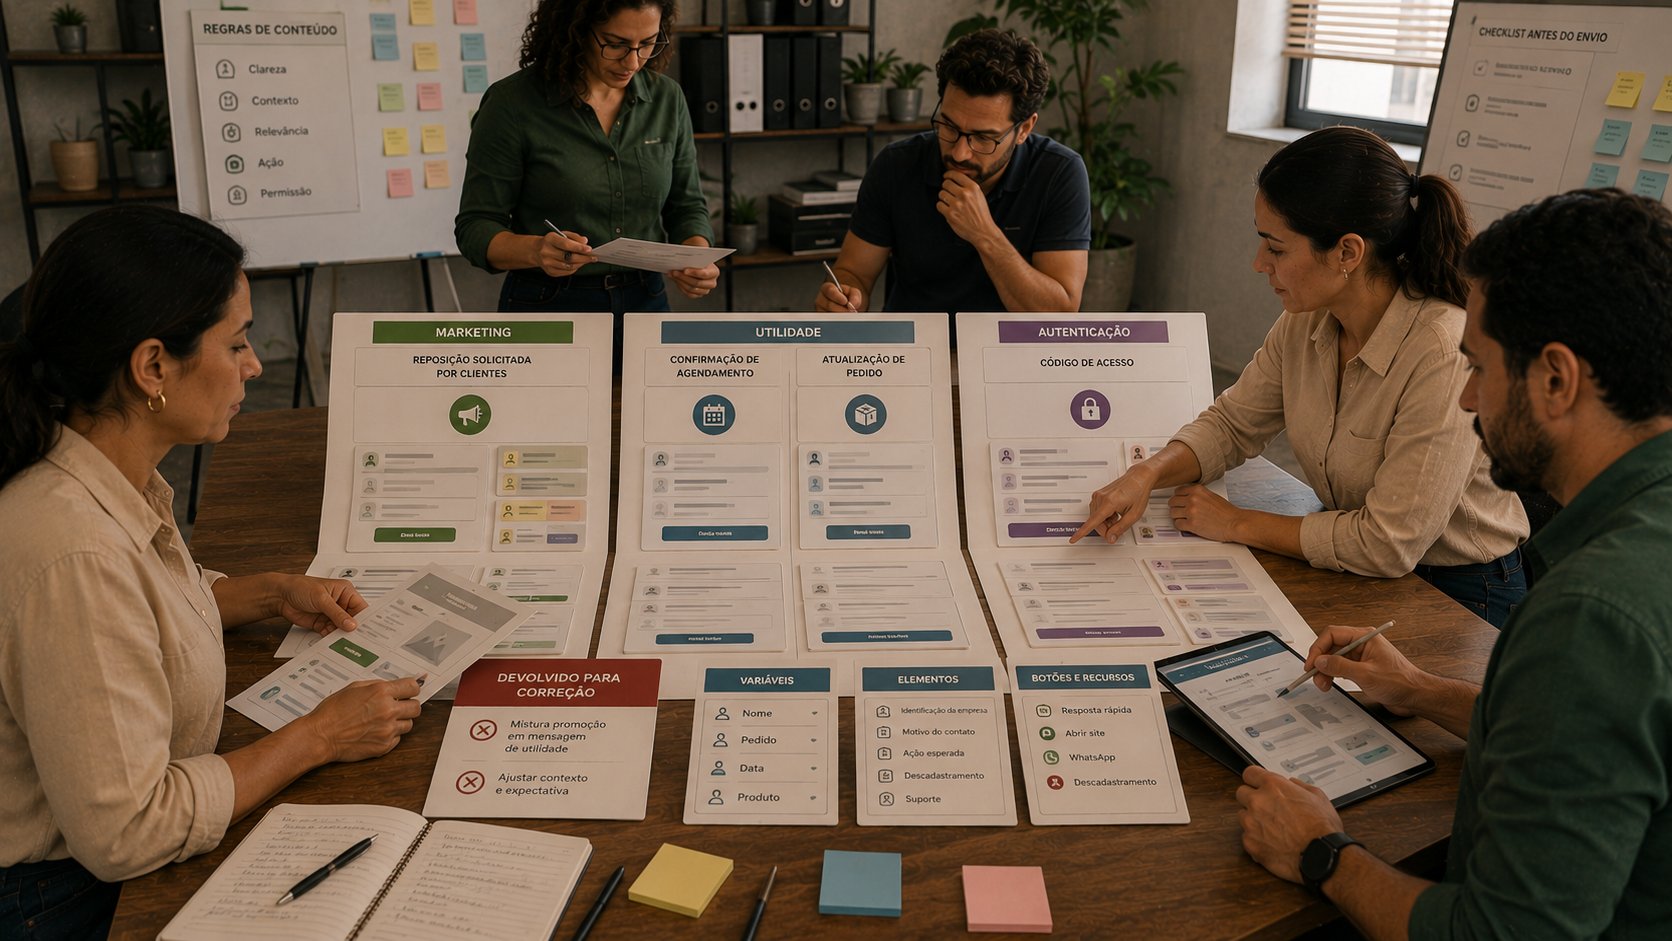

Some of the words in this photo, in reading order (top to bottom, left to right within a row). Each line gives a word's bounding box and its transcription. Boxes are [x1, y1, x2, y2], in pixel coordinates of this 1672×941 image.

[203, 24, 252, 34] REGRAS
[256, 25, 270, 35] DE
[274, 23, 337, 35] CONTEÚDO
[1479, 27, 1526, 39] CHECKLIST
[1527, 29, 1558, 40] ANTES
[1560, 31, 1574, 41] DO
[1576, 32, 1607, 42] ENVIO
[249, 64, 286, 74] Clareza
[252, 96, 298, 106] Contexto
[255, 126, 309, 137] Relevância
[258, 158, 284, 169] Ação
[260, 186, 312, 198] Permissão
[436, 328, 511, 337] MARKETING
[756, 327, 821, 337] UTILIDADE
[1039, 325, 1130, 339] AUTENTICAÇÃO
[413, 354, 470, 366] REPOSIÇÃO
[473, 356, 531, 364] SOLICITADA
[670, 353, 743, 366] CONFIRMAÇÃO
[746, 356, 759, 364] DE
[823, 353, 889, 366] ATUALIZAÇÃO
[893, 356, 905, 364] DE
[1040, 356, 1078, 367] CÓDIGO
[1097, 359, 1134, 367] ACESSO
[677, 369, 754, 377] AGENDAMENTO
[847, 369, 882, 377] PEDIDO
[497, 673, 580, 683] DEVOLVIDO
[584, 673, 620, 683] PARA
[741, 674, 794, 685] VARIÁVEIS
[898, 675, 959, 684] ELEMENTOS
[1032, 671, 1072, 682] BOTÕES
[1074, 674, 1081, 682] E
[1083, 673, 1135, 682] RECURSOS
[517, 686, 595, 700] CORREÇÃO
[743, 709, 772, 717] Nome
[1062, 707, 1102, 716] Resposta
[1104, 705, 1132, 715] rápida
[511, 720, 550, 728] Mistura
[528, 733, 586, 742] mensagem
[1066, 729, 1087, 737] Abrir
[1089, 729, 1105, 737] site
[741, 736, 776, 744] Pedido
[505, 745, 519, 753] de
[522, 745, 568, 753] utilidade
[903, 749, 925, 759] Ação
[926, 749, 965, 759] esperada
[1069, 753, 1115, 763] WhatsApp
[740, 764, 764, 772] Data
[498, 773, 537, 784] Ajustar
[905, 772, 984, 780] Descadastramento
[1074, 778, 1157, 787] Descadastramento
[505, 786, 569, 796] expectativa
[738, 793, 780, 802] Produto
[906, 795, 941, 804] Suporte
